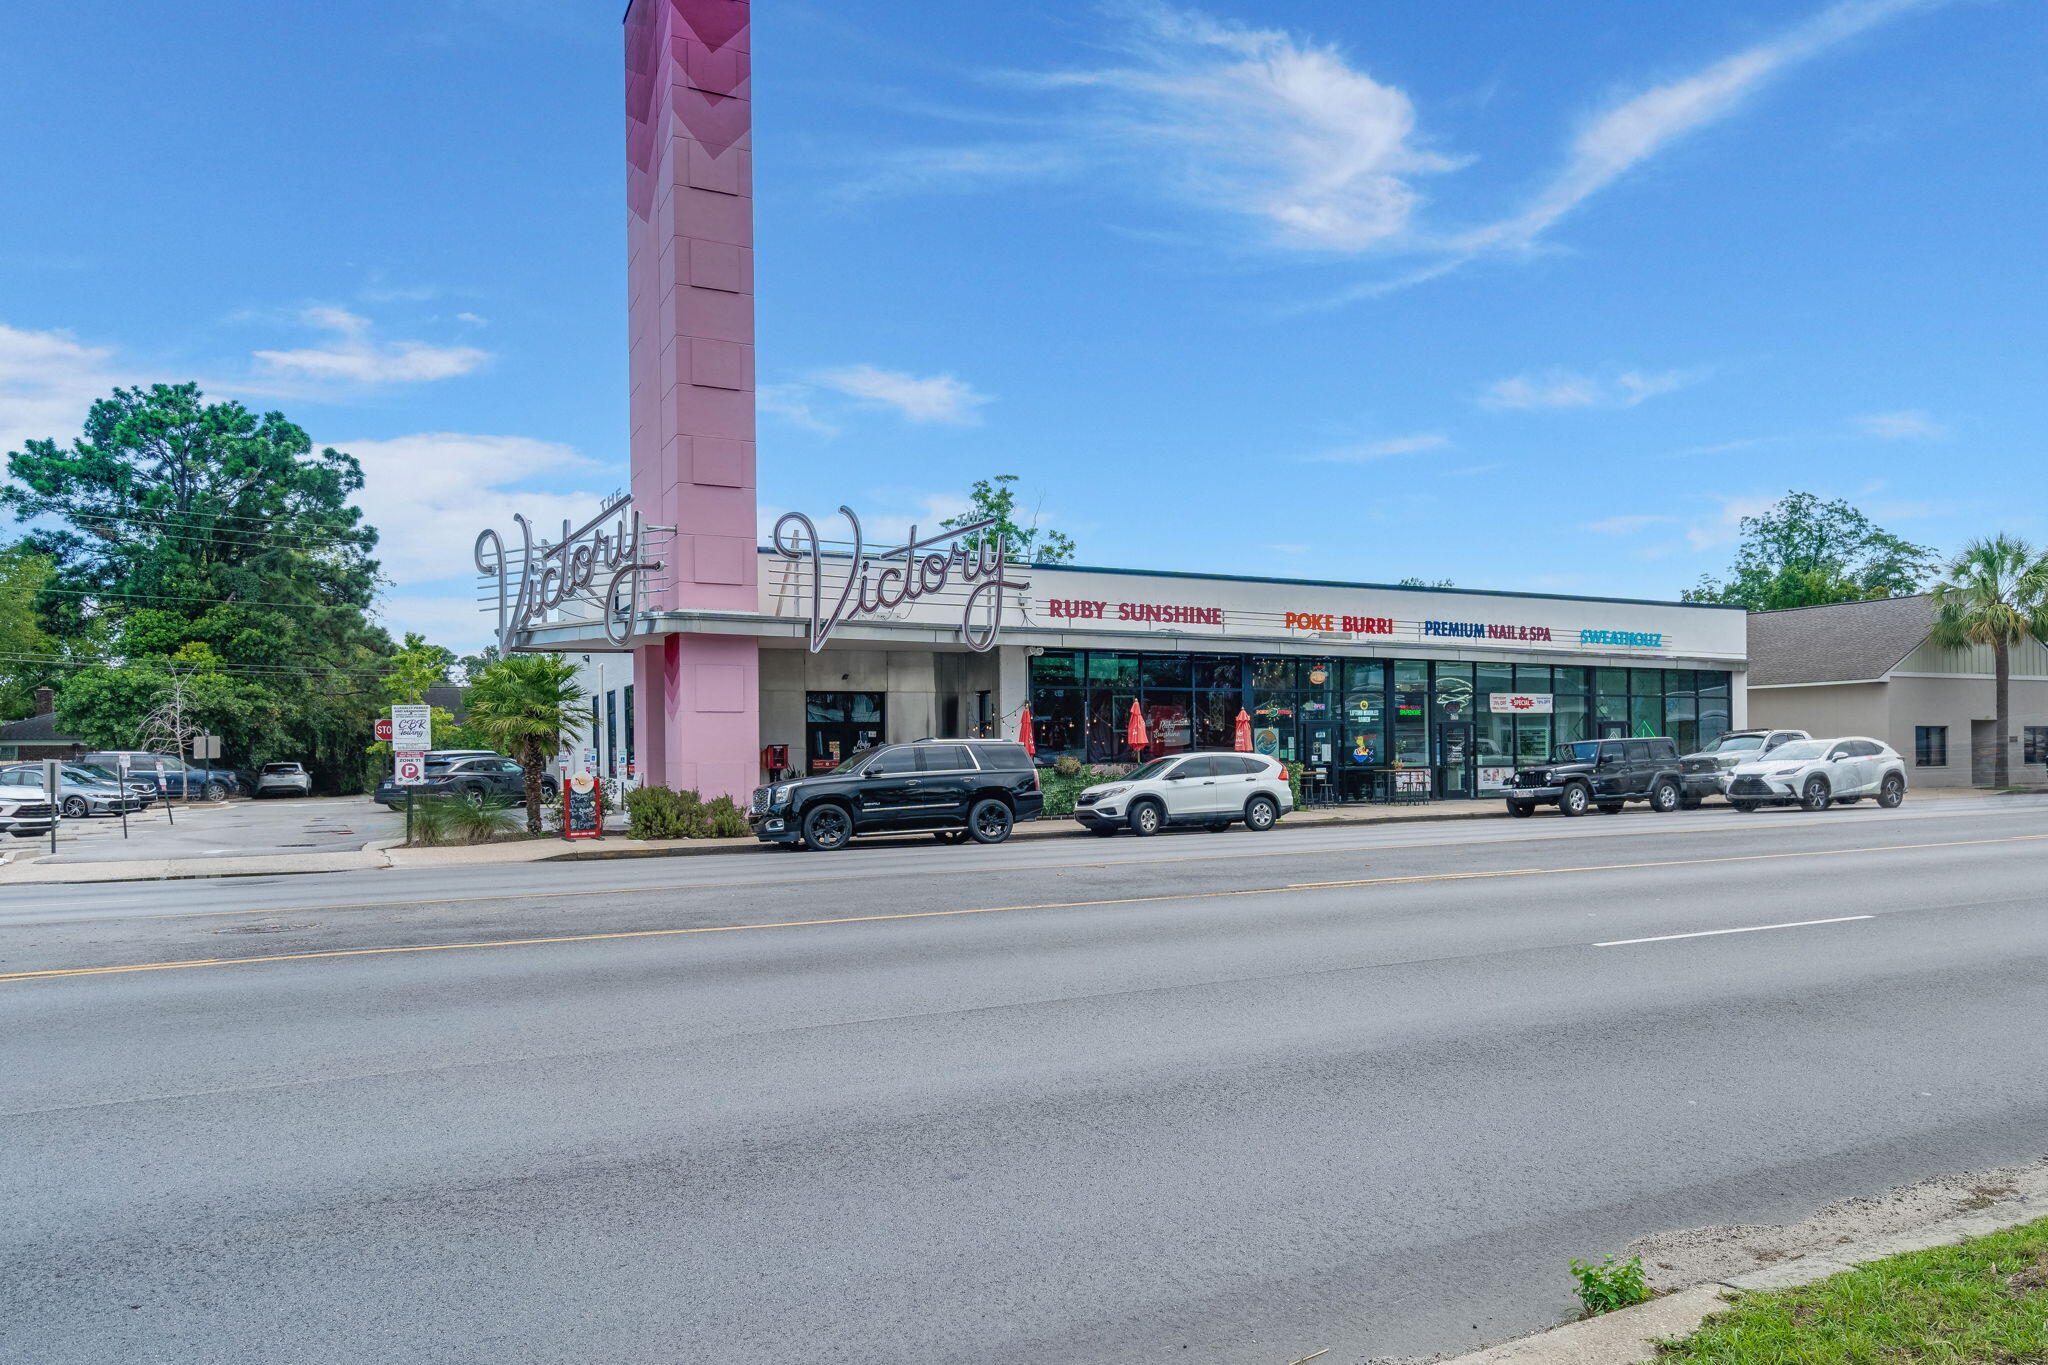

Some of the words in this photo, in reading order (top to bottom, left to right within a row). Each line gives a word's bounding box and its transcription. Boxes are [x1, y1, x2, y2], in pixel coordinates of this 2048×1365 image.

[600, 488, 622, 513] THE
[474, 494, 664, 662] Victory
[773, 505, 1030, 653] Victory
[1049, 599, 1107, 619] RUBY
[1118, 603, 1222, 625] SUNSHINE
[1285, 612, 1334, 631] POKE
[1342, 615, 1393, 634] BURRI
[1424, 620, 1486, 638] PREMIUM
[1488, 624, 1518, 640] NAIL
[1529, 626, 1552, 642] SPA
[1580, 629, 1663, 648] SWEATHOUZ
[377, 725, 392, 734] STO
[398, 719, 427, 730] CBR
[398, 728, 424, 738] Towing
